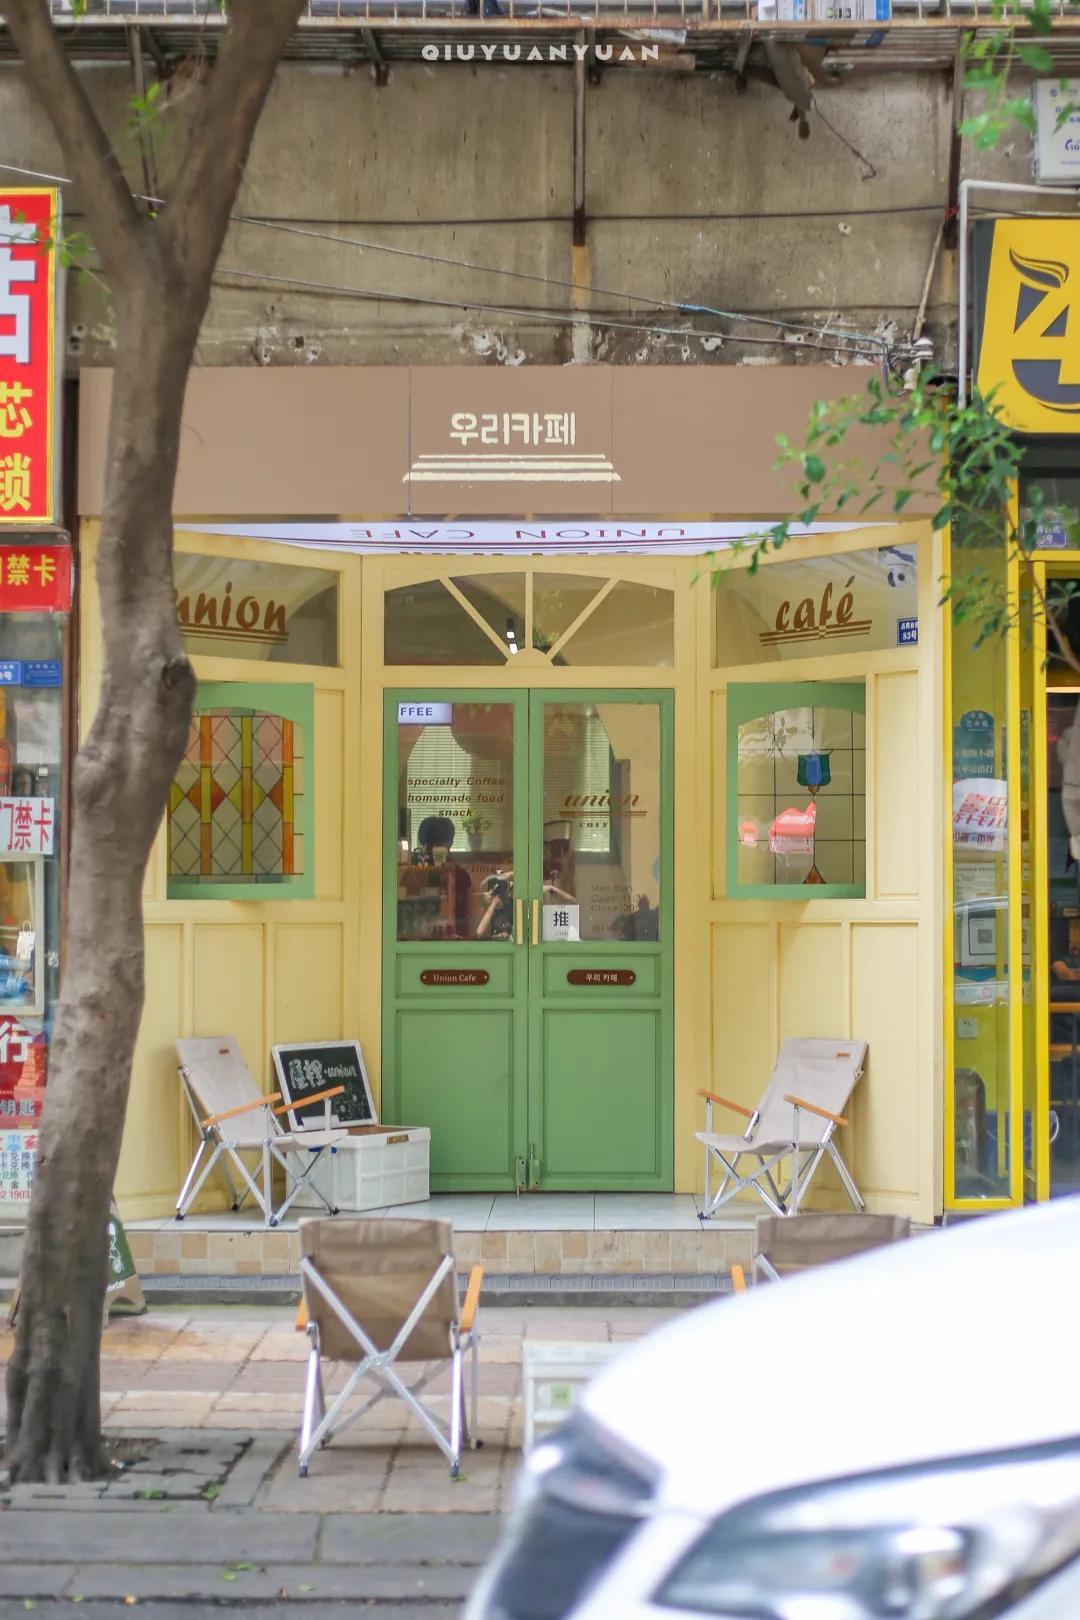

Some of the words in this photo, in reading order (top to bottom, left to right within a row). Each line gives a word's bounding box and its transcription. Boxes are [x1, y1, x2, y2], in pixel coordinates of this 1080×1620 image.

[450, 412, 576, 446] 우리카페
[350, 529, 475, 539] CAFE
[516, 528, 685, 539] UNION
[0, 554, 56, 587] 禁卡
[775, 575, 855, 632] café
[407, 777, 461, 787] specialty
[407, 793, 471, 803] homemade
[437, 808, 472, 817] snack
[553, 910, 569, 927] 推
[433, 974, 457, 982] Union
[459, 974, 477, 982] Cafe
[585, 973, 600, 983] 우리
[603, 973, 618, 982] 카페
